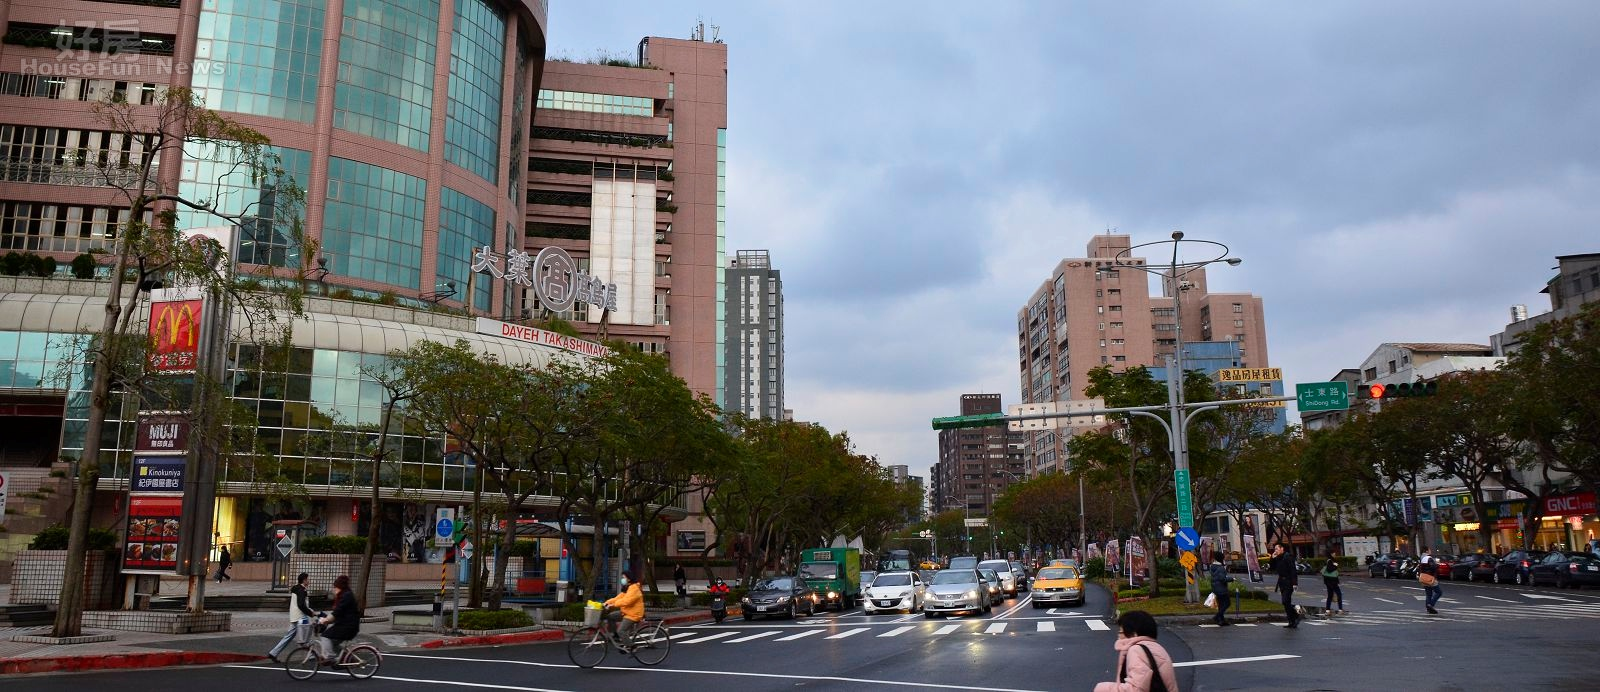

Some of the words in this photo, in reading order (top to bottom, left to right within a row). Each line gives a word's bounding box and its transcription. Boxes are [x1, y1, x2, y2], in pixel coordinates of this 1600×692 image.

[471, 246, 532, 287] 大葉
[502, 323, 539, 342] DAYEH
[544, 331, 609, 358] TAKASHIMAYA
[1222, 369, 1280, 380] 逸品房屋租賃
[1305, 388, 1339, 398] 士東路
[149, 424, 179, 440] MUJI
[151, 440, 174, 448] 無印良品
[149, 469, 181, 477] Kinokuniya
[138, 478, 179, 487] 紀伊國屋書店
[1547, 497, 1577, 512] GNC
